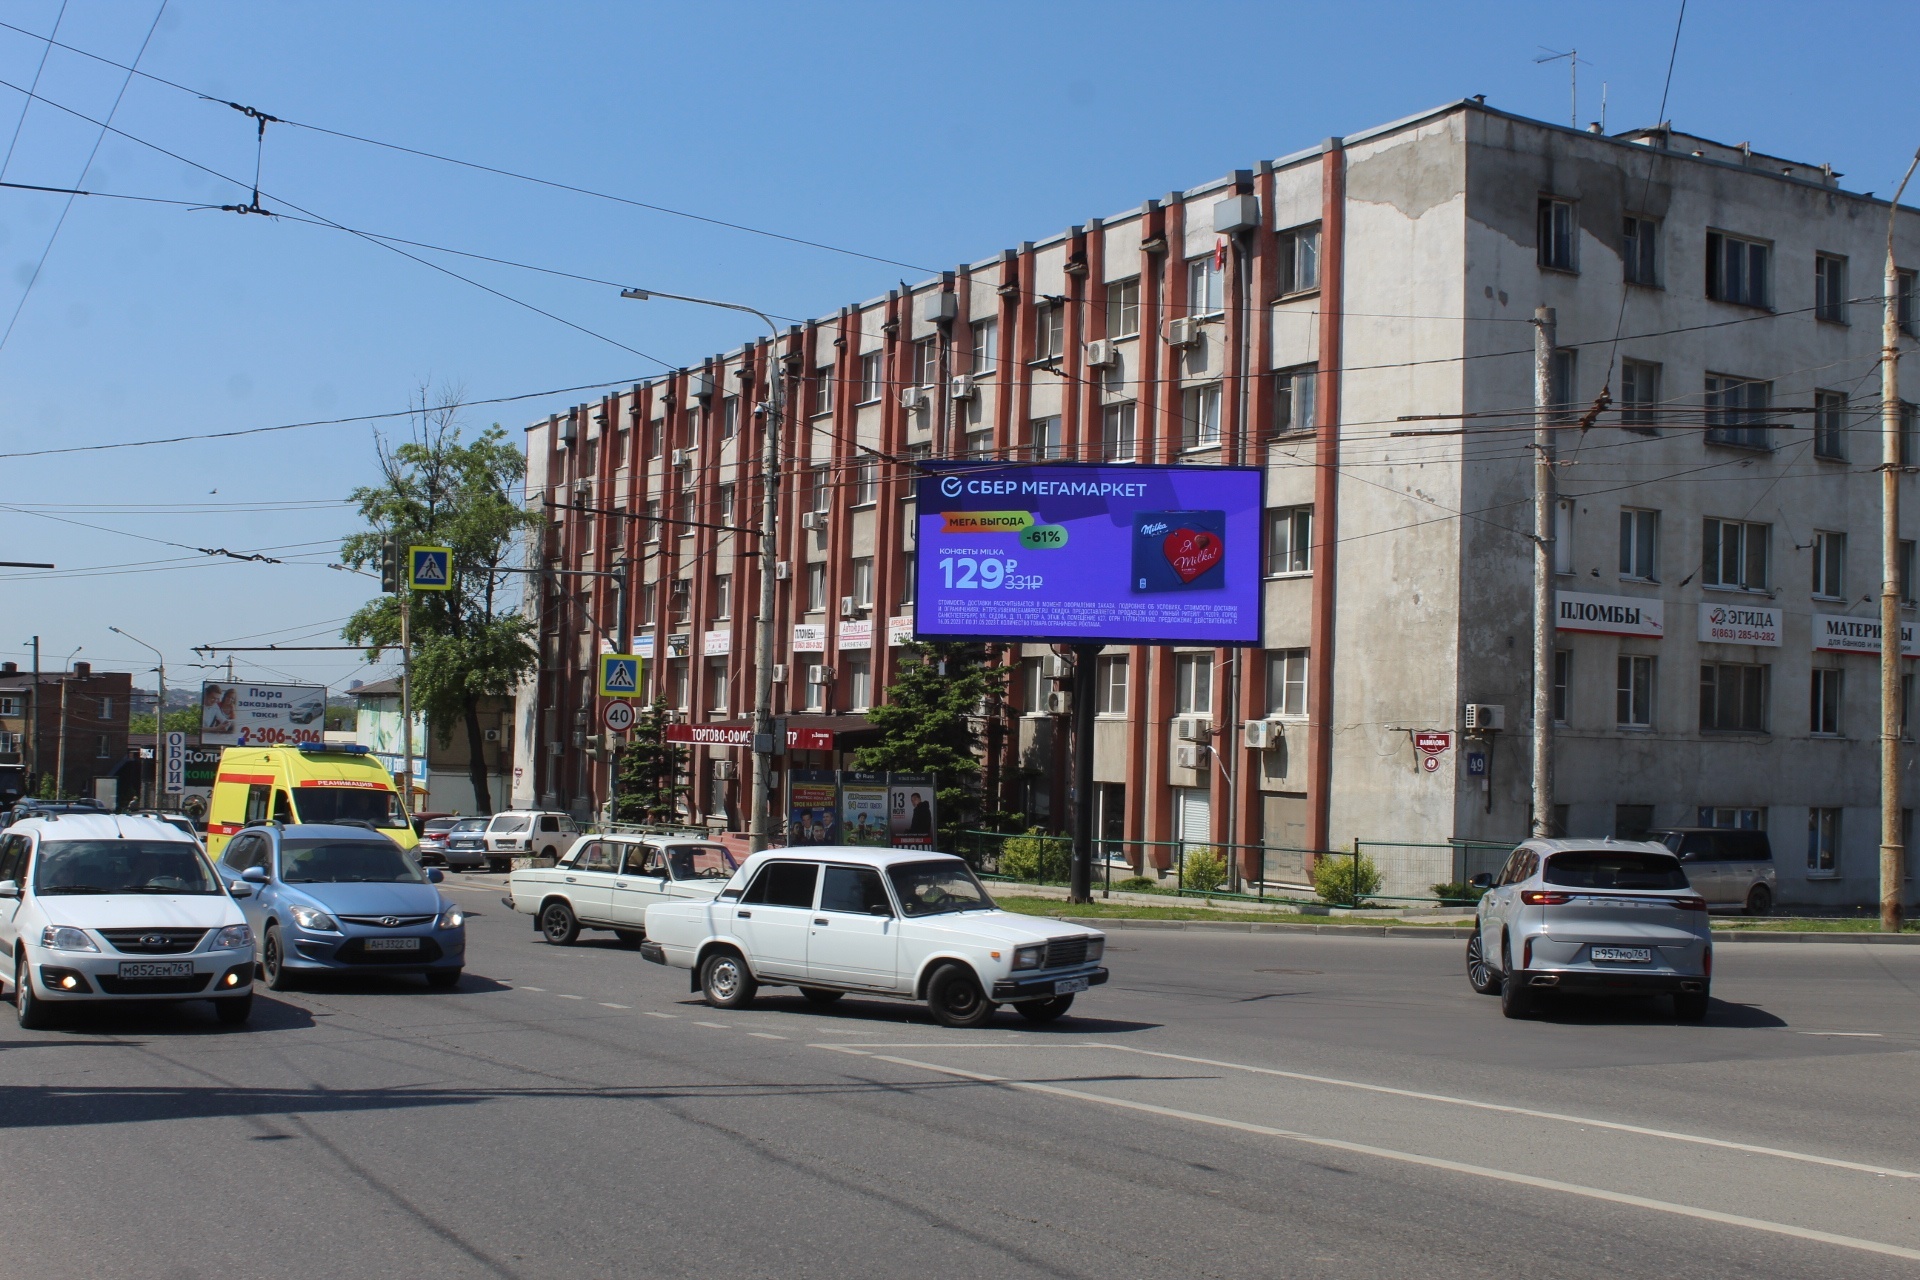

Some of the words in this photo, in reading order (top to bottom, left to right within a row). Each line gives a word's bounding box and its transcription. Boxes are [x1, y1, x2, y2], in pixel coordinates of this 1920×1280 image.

[967, 480, 1017, 495] СБЕР
[1022, 481, 1148, 497] МЕГАМАРКЕТ
[949, 518, 978, 527] МЕГА
[980, 516, 1025, 527] ВЫГОДА
[1140, 522, 1168, 535] Milka
[1026, 530, 1061, 543] -61%
[980, 548, 1005, 556] MILKA
[1560, 601, 1641, 625] ПЛОМБЫ
[1728, 609, 1774, 629] ЭГИДА
[1711, 627, 1736, 641] 8(863)
[1738, 629, 1776, 642] 285-0-282
[1826, 620, 1913, 642] МАТЕРИЫ
[1828, 639, 1841, 648] для
[1842, 638, 1866, 648] банков
[249, 687, 283, 700] Пора
[238, 700, 293, 709] заказывать
[251, 711, 278, 719] такси
[609, 709, 629, 723] 40
[241, 726, 321, 744] 2-306-306
[691, 728, 751, 743] ТОРГОВО-ОФИС
[168, 733, 182, 784] ОБОИ
[1427, 759, 1436, 768] 49
[1470, 758, 1484, 772] 49
[317, 780, 374, 788] РЕАНИМАЦИЯ
[892, 792, 906, 809] 13
